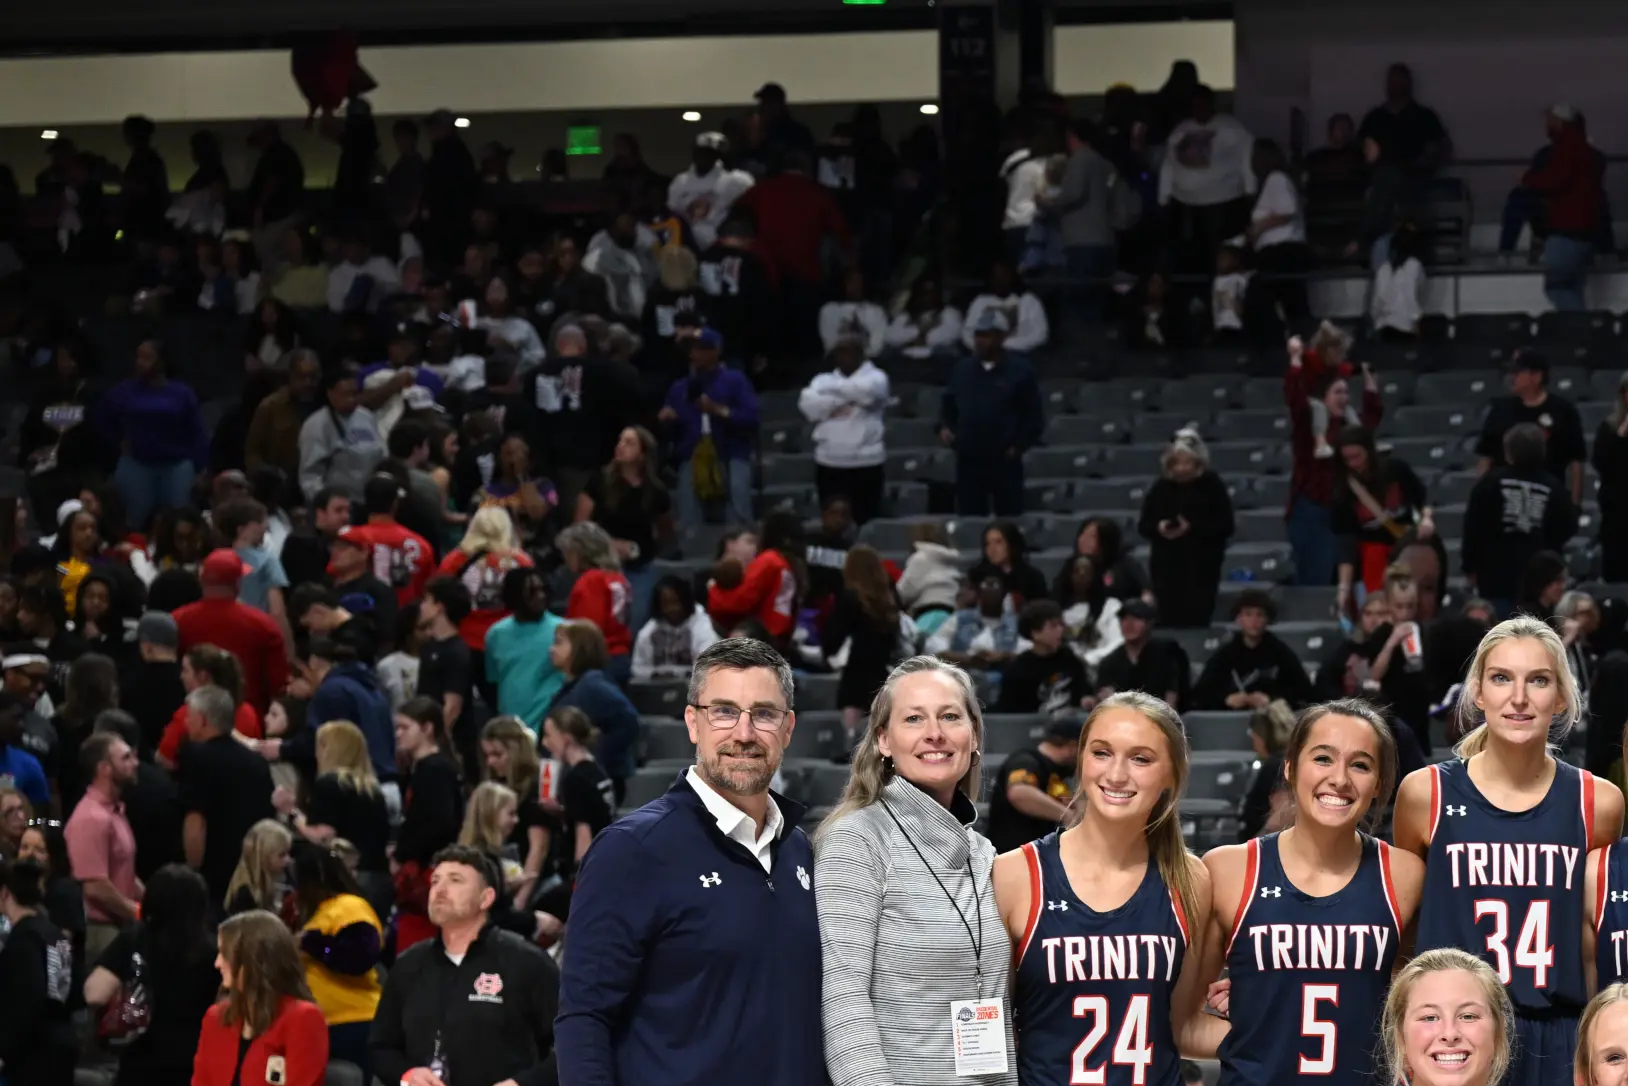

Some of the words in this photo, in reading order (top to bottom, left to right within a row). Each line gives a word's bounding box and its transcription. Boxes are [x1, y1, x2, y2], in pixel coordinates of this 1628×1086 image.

[1445, 842, 1580, 891] TRINITY
[1040, 934, 1178, 984] TRINITY
[1248, 923, 1391, 972] TRINITY
[1473, 897, 1556, 989] 34
[976, 1010, 999, 1020] ZONES
[1297, 982, 1340, 1077] 5
